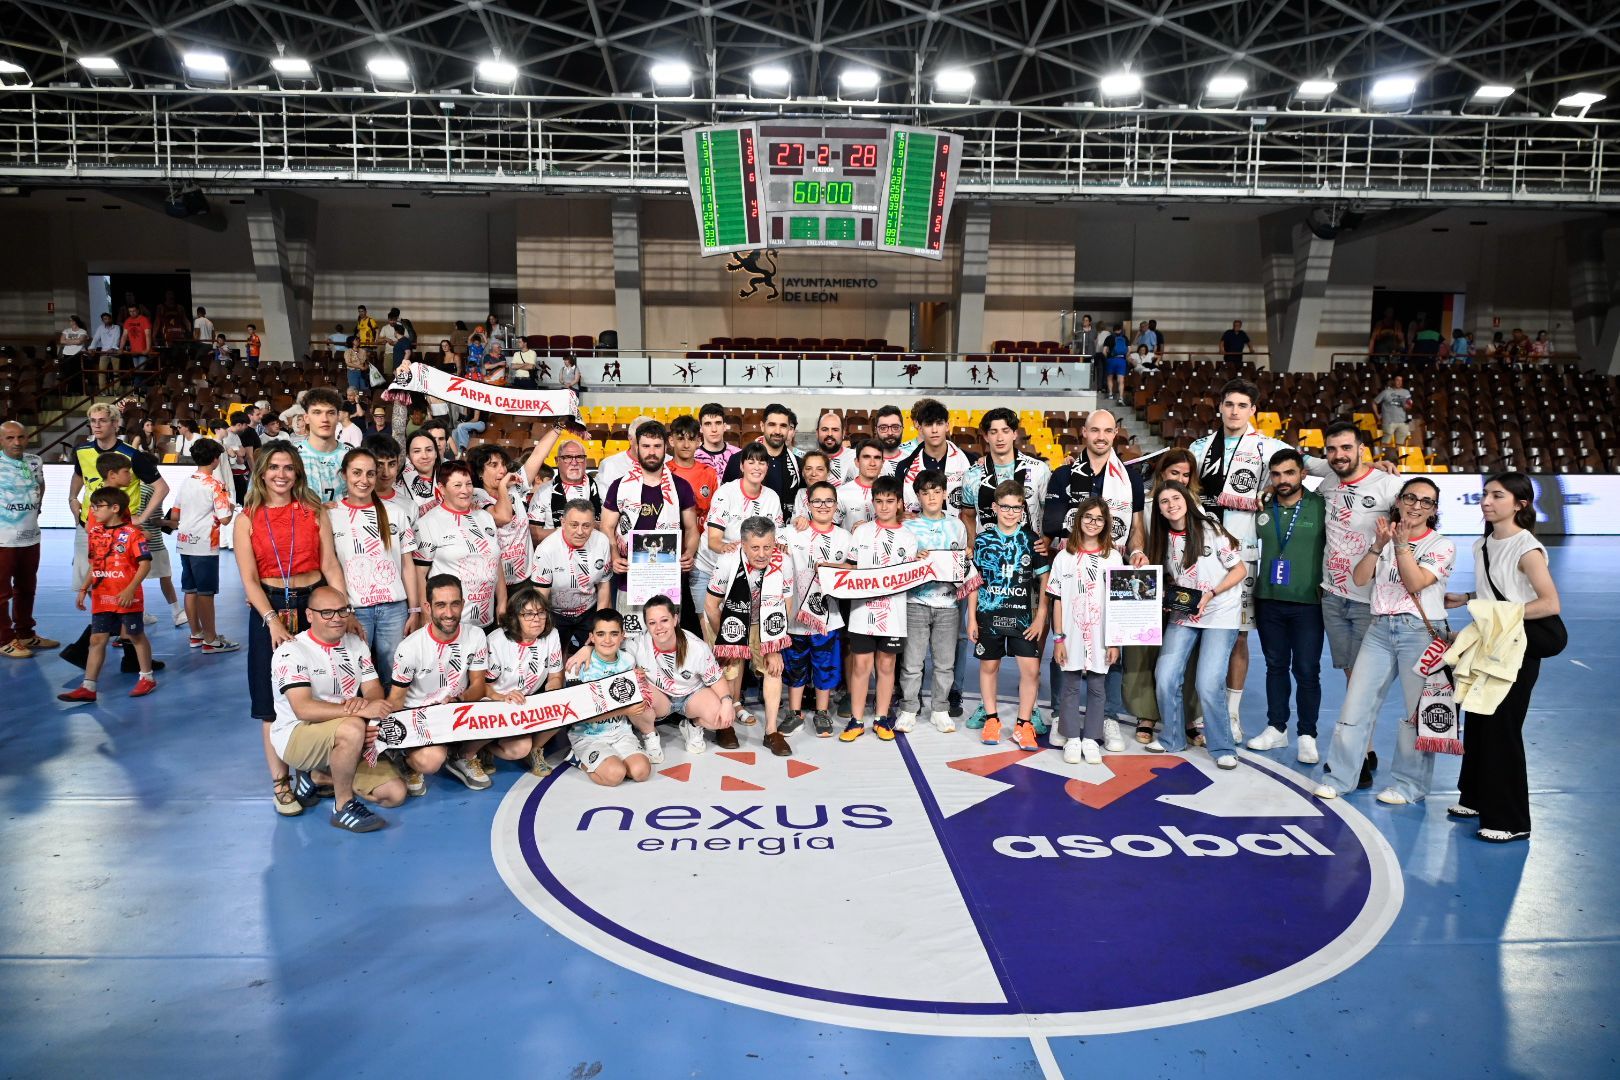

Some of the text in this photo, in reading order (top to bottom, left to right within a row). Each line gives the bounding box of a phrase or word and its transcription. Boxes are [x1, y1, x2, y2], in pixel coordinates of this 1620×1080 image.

[777, 143, 803, 166] 27
[818, 146, 829, 165] 2
[850, 145, 876, 167] 28
[942, 144, 949, 154] 9
[749, 172, 755, 182] 6
[794, 182, 852, 204] 60:00
[785, 278, 878, 288] AYUNTAMIENTO
[785, 289, 838, 303] DE LEÓN
[446, 376, 554, 415] ZARPA CAZURRA
[324, 488, 335, 501] 7
[833, 562, 938, 590] ZARPA CAZURRA
[987, 585, 1028, 597] ABANCA
[623, 621, 643, 631] EGA
[453, 702, 579, 731] ZARPA CAZURRA
[576, 804, 893, 831] nexus
[636, 832, 835, 856] energía
[992, 824, 1336, 859] asobal
